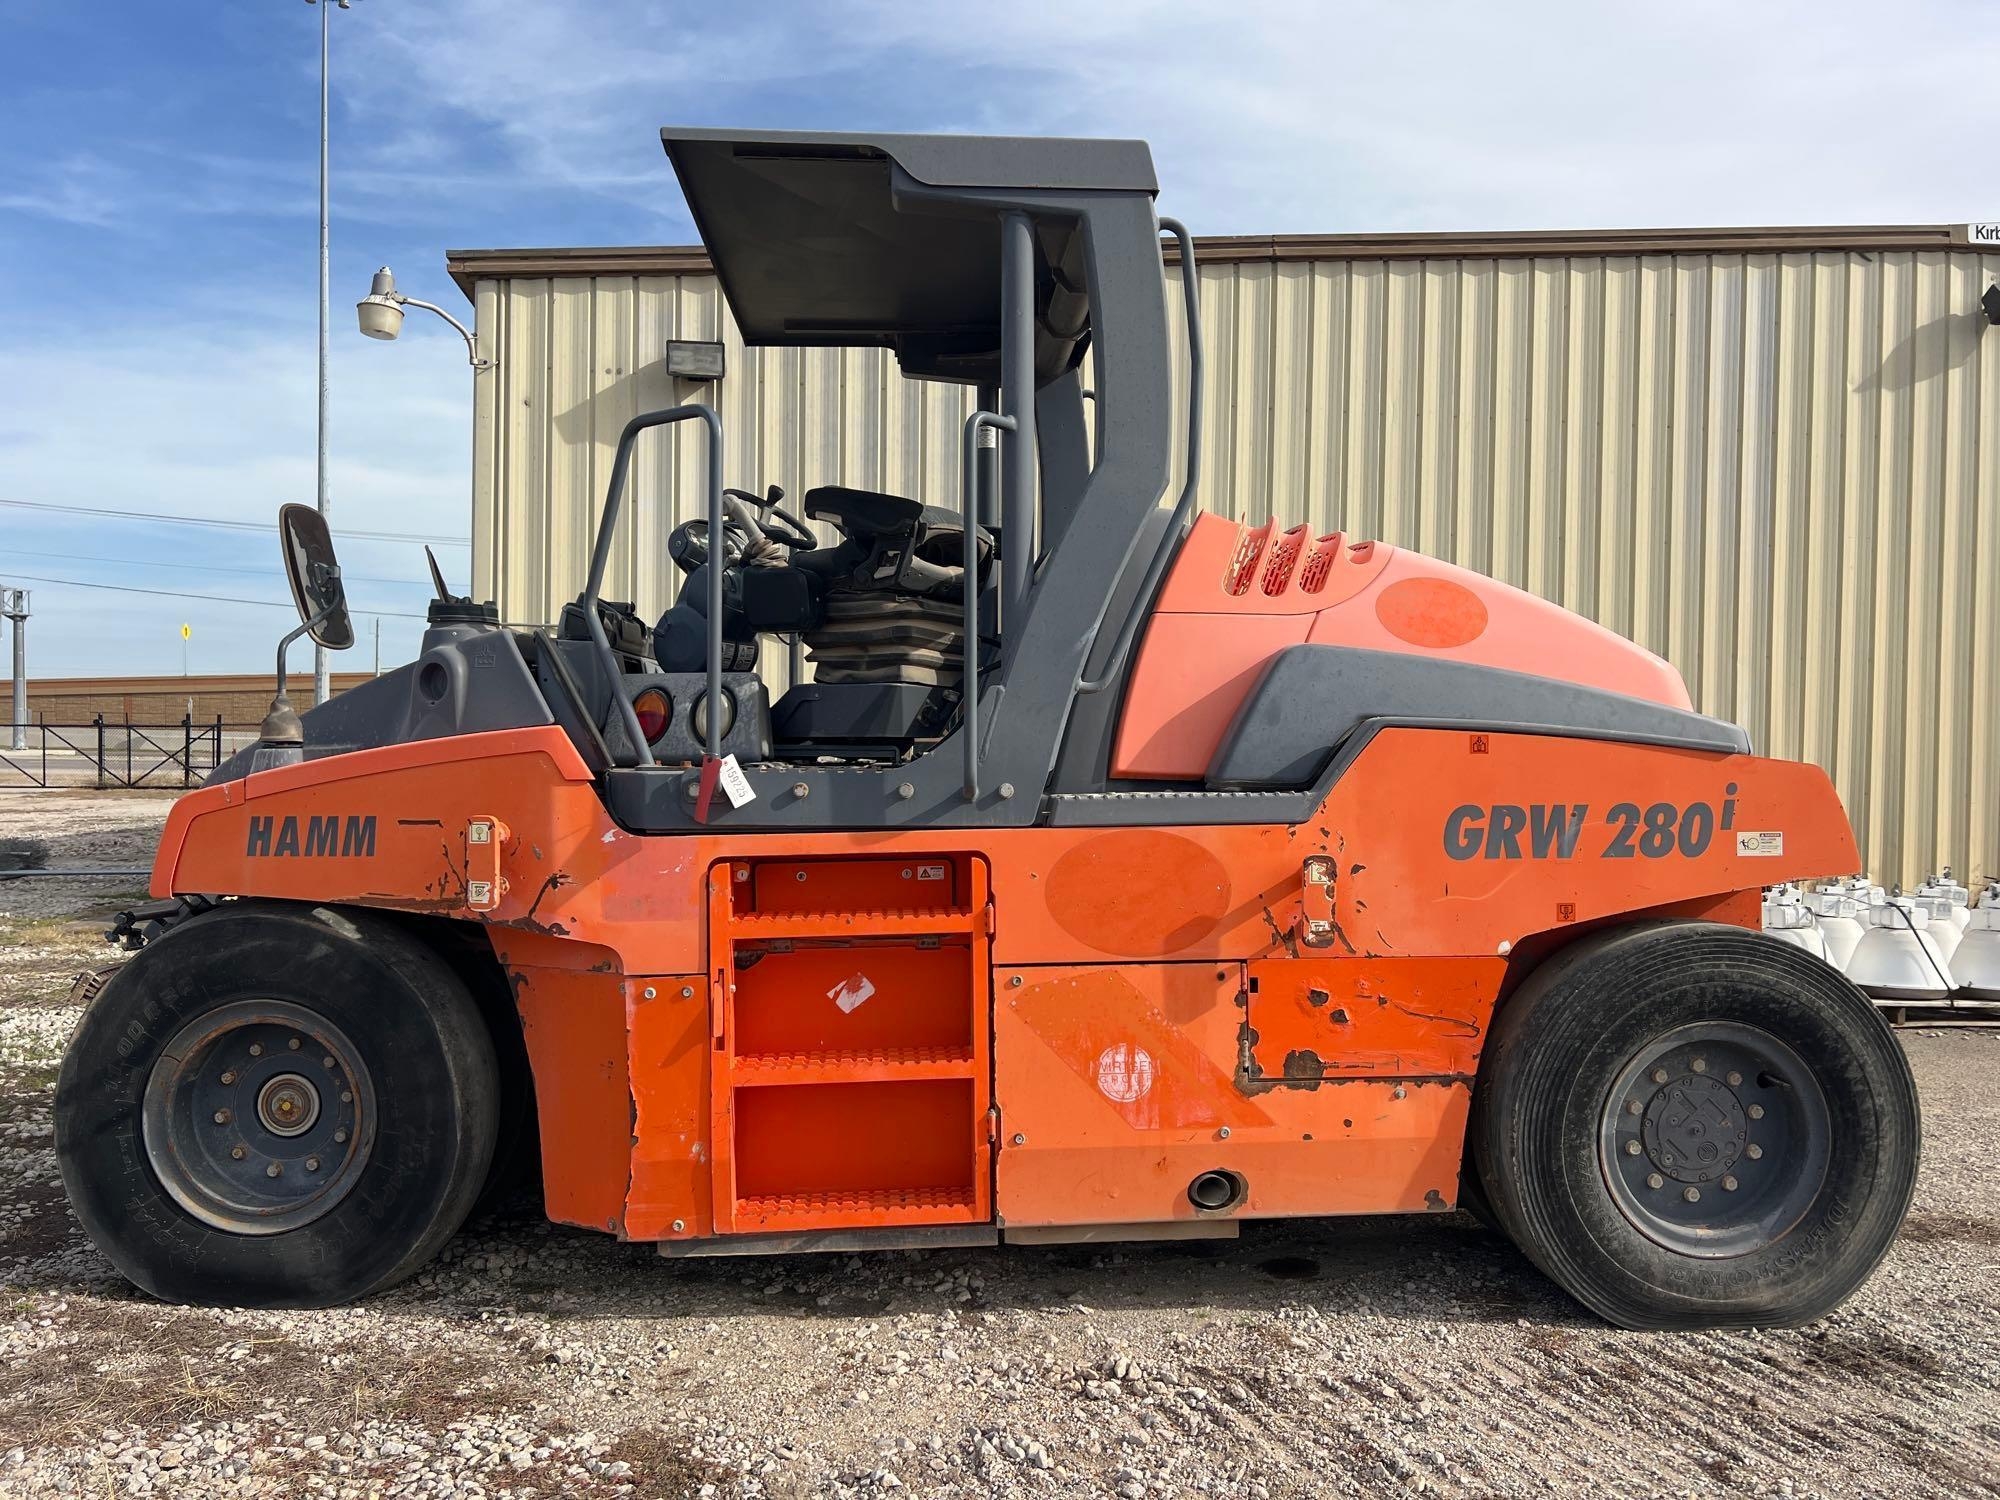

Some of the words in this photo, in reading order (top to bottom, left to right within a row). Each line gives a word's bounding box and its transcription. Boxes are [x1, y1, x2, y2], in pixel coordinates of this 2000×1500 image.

[725, 766, 748, 798] 159225
[246, 816, 377, 857] HAMM
[1443, 804, 1588, 861] GRW
